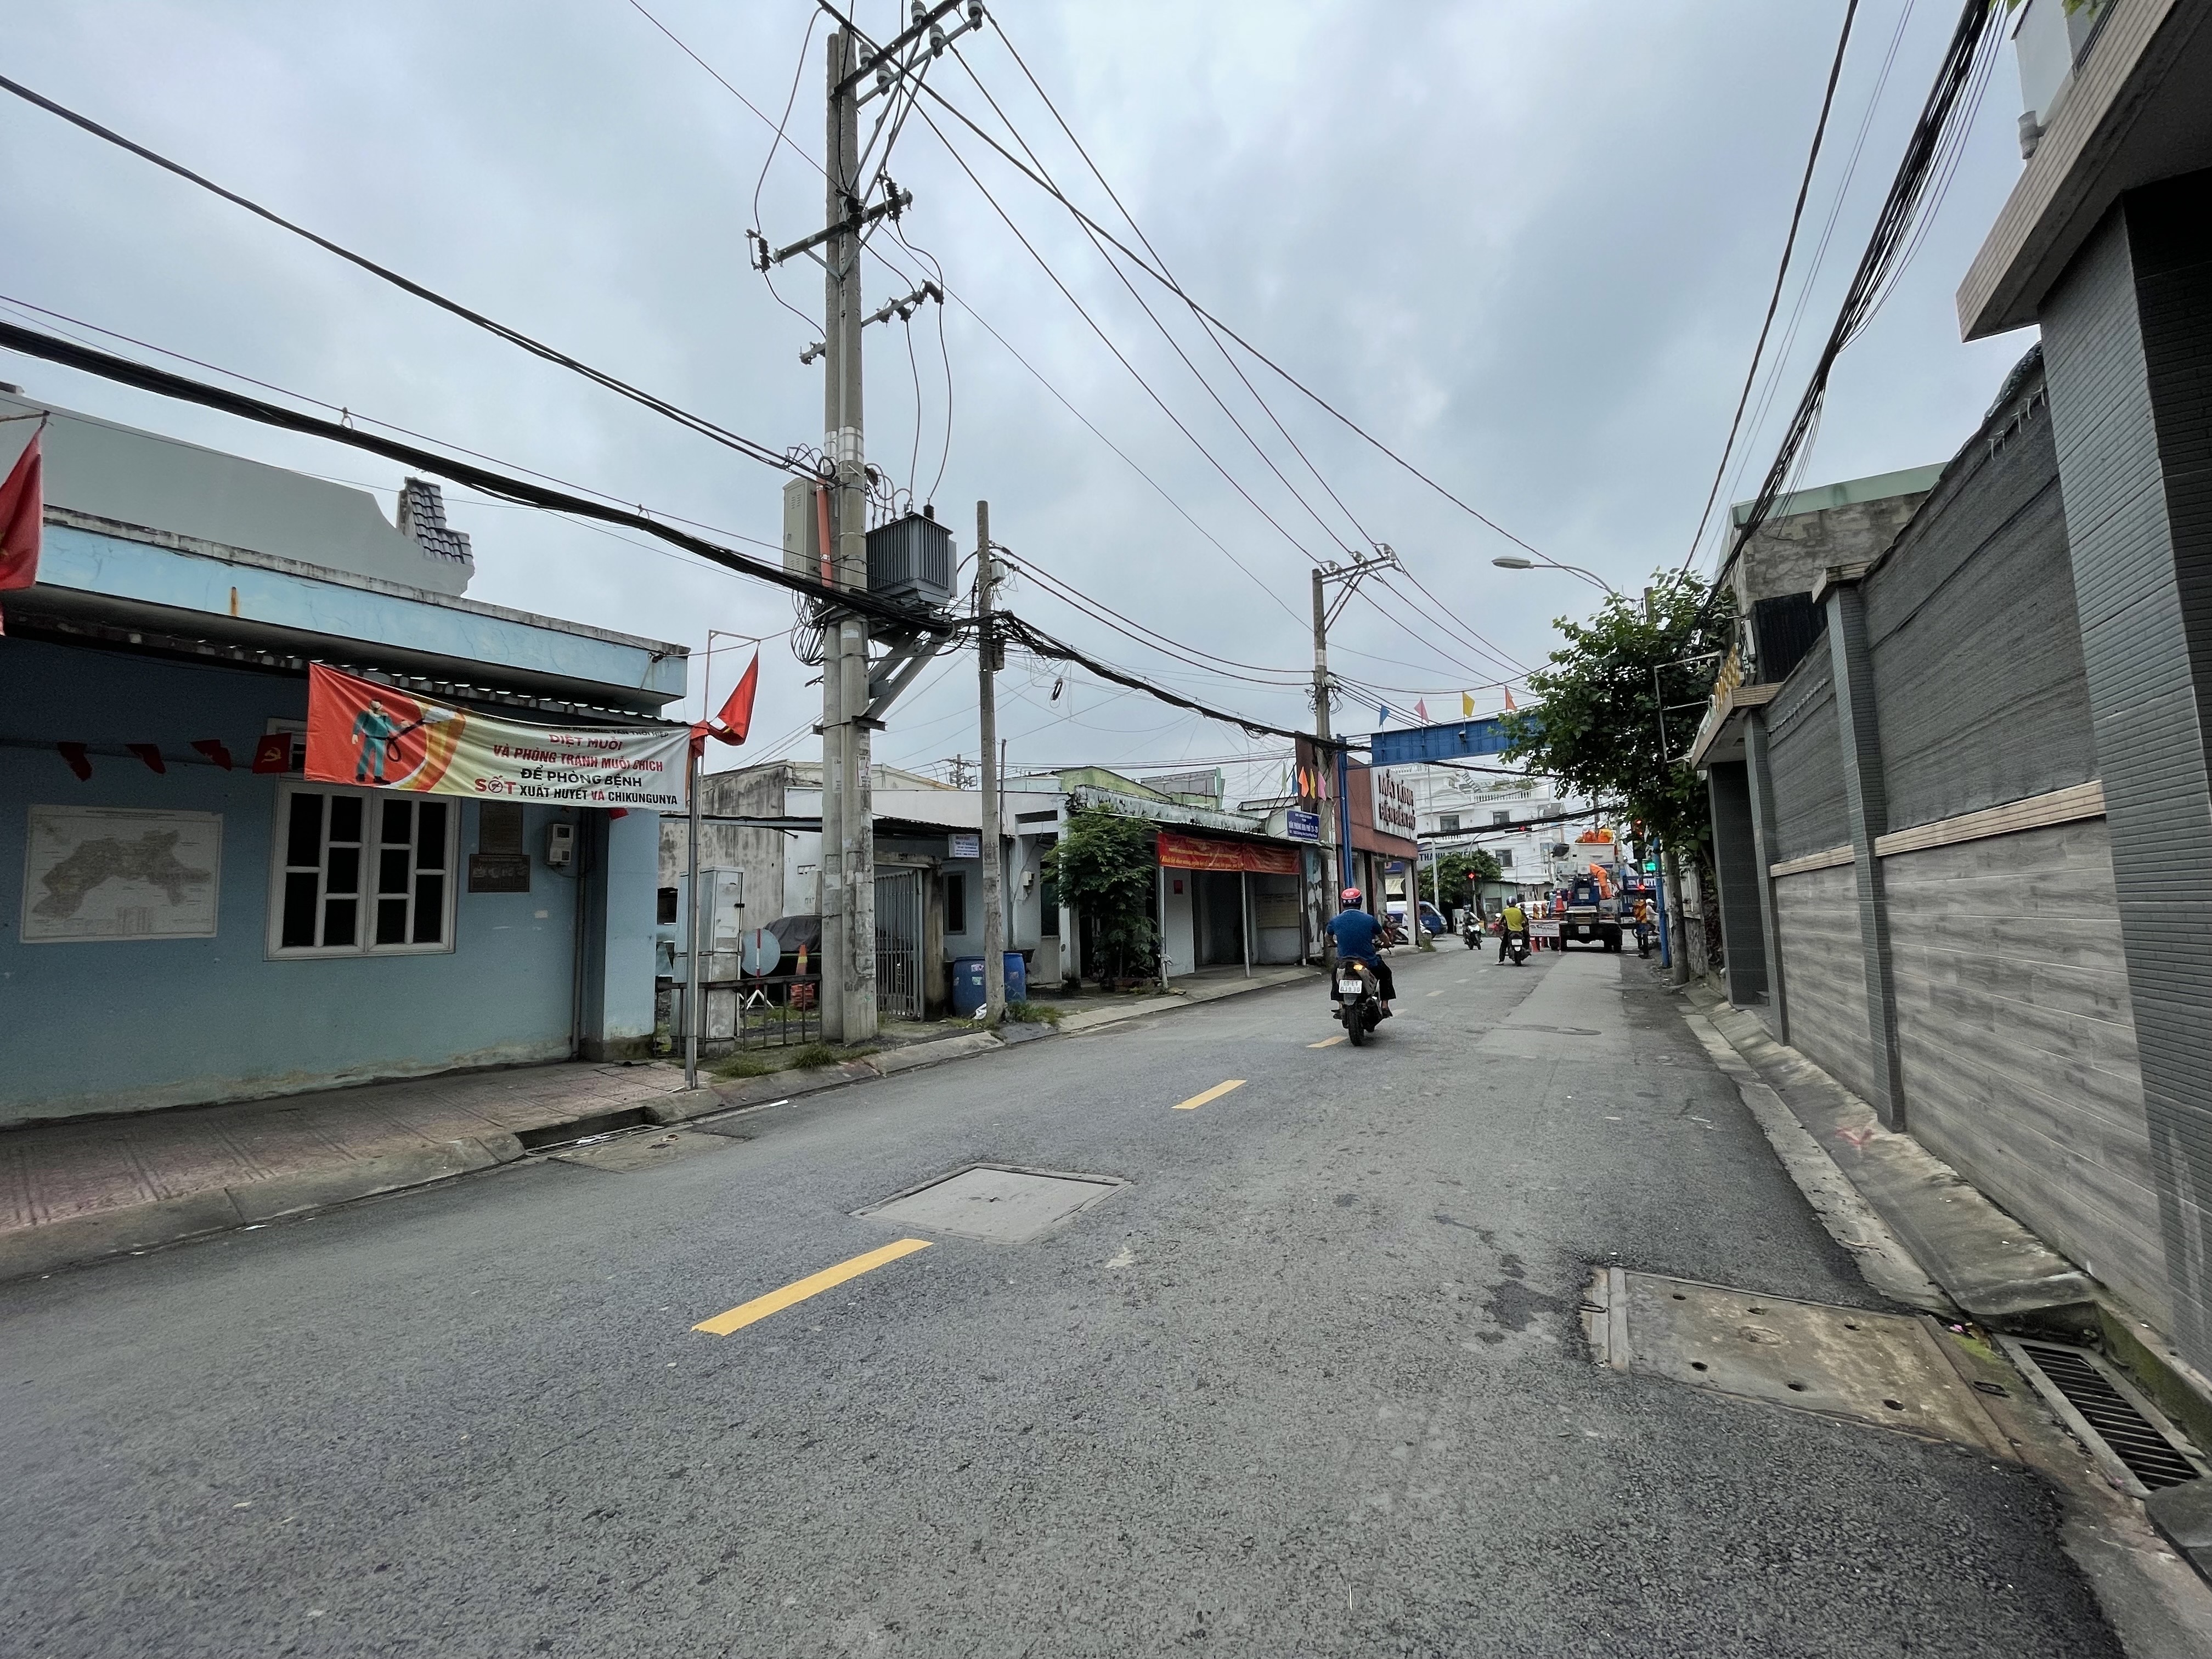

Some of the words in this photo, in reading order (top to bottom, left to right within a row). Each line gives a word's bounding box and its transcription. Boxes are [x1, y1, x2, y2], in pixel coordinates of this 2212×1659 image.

[549, 734, 583, 748] DIỆT
[587, 736, 623, 751] MUỖI
[494, 744, 510, 758] VÀ
[514, 747, 557, 764] PHÒNG
[561, 752, 598, 768] TRÁNH
[601, 754, 630, 770] MUỖI
[632, 759, 663, 772] CHÍCH
[520, 765, 543, 780] ĐỂ
[547, 770, 602, 785] PHÒNG
[605, 773, 642, 788] BỆNH
[475, 775, 516, 794] SỐT
[520, 783, 550, 798] XUẤT
[554, 786, 588, 800] HUYẾT
[591, 787, 605, 801] VÀ
[608, 791, 678, 805] CHIKUNGUNYA
